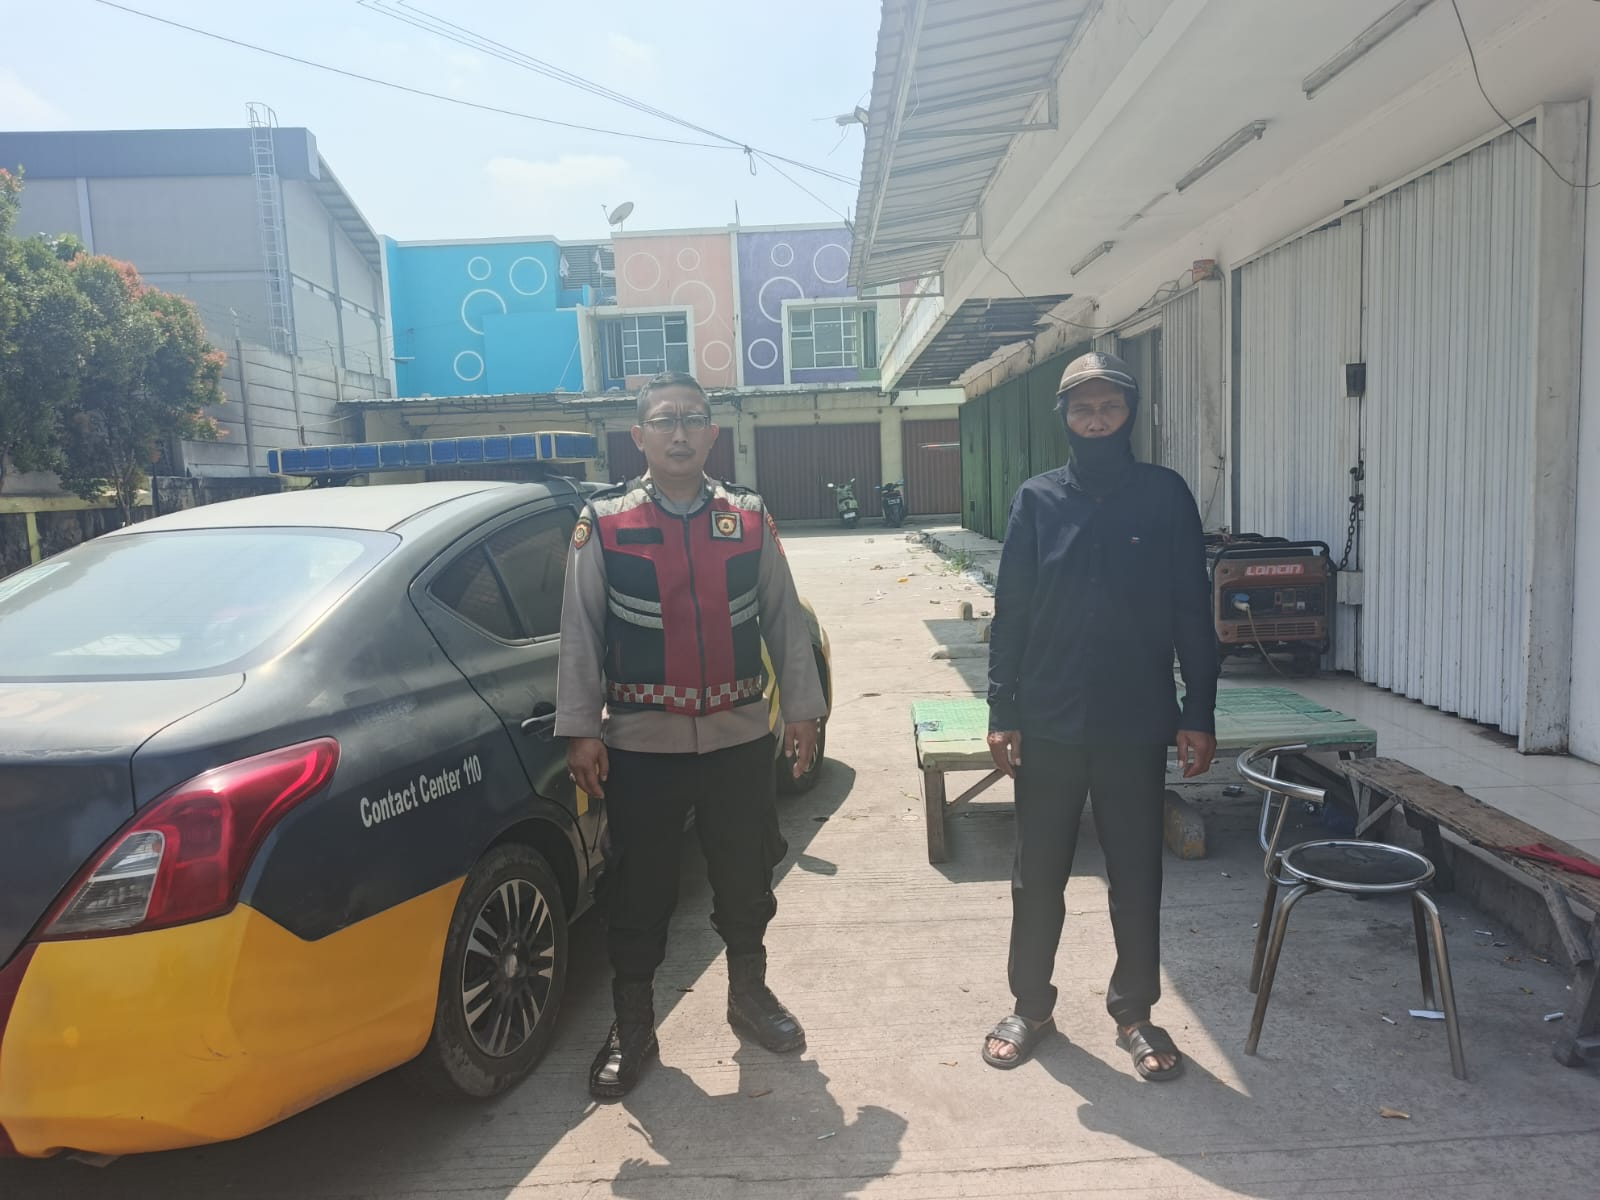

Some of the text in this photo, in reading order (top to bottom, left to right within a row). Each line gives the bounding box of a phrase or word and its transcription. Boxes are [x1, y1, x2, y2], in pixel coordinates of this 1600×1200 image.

[360, 754, 482, 828] Contact Center 110
